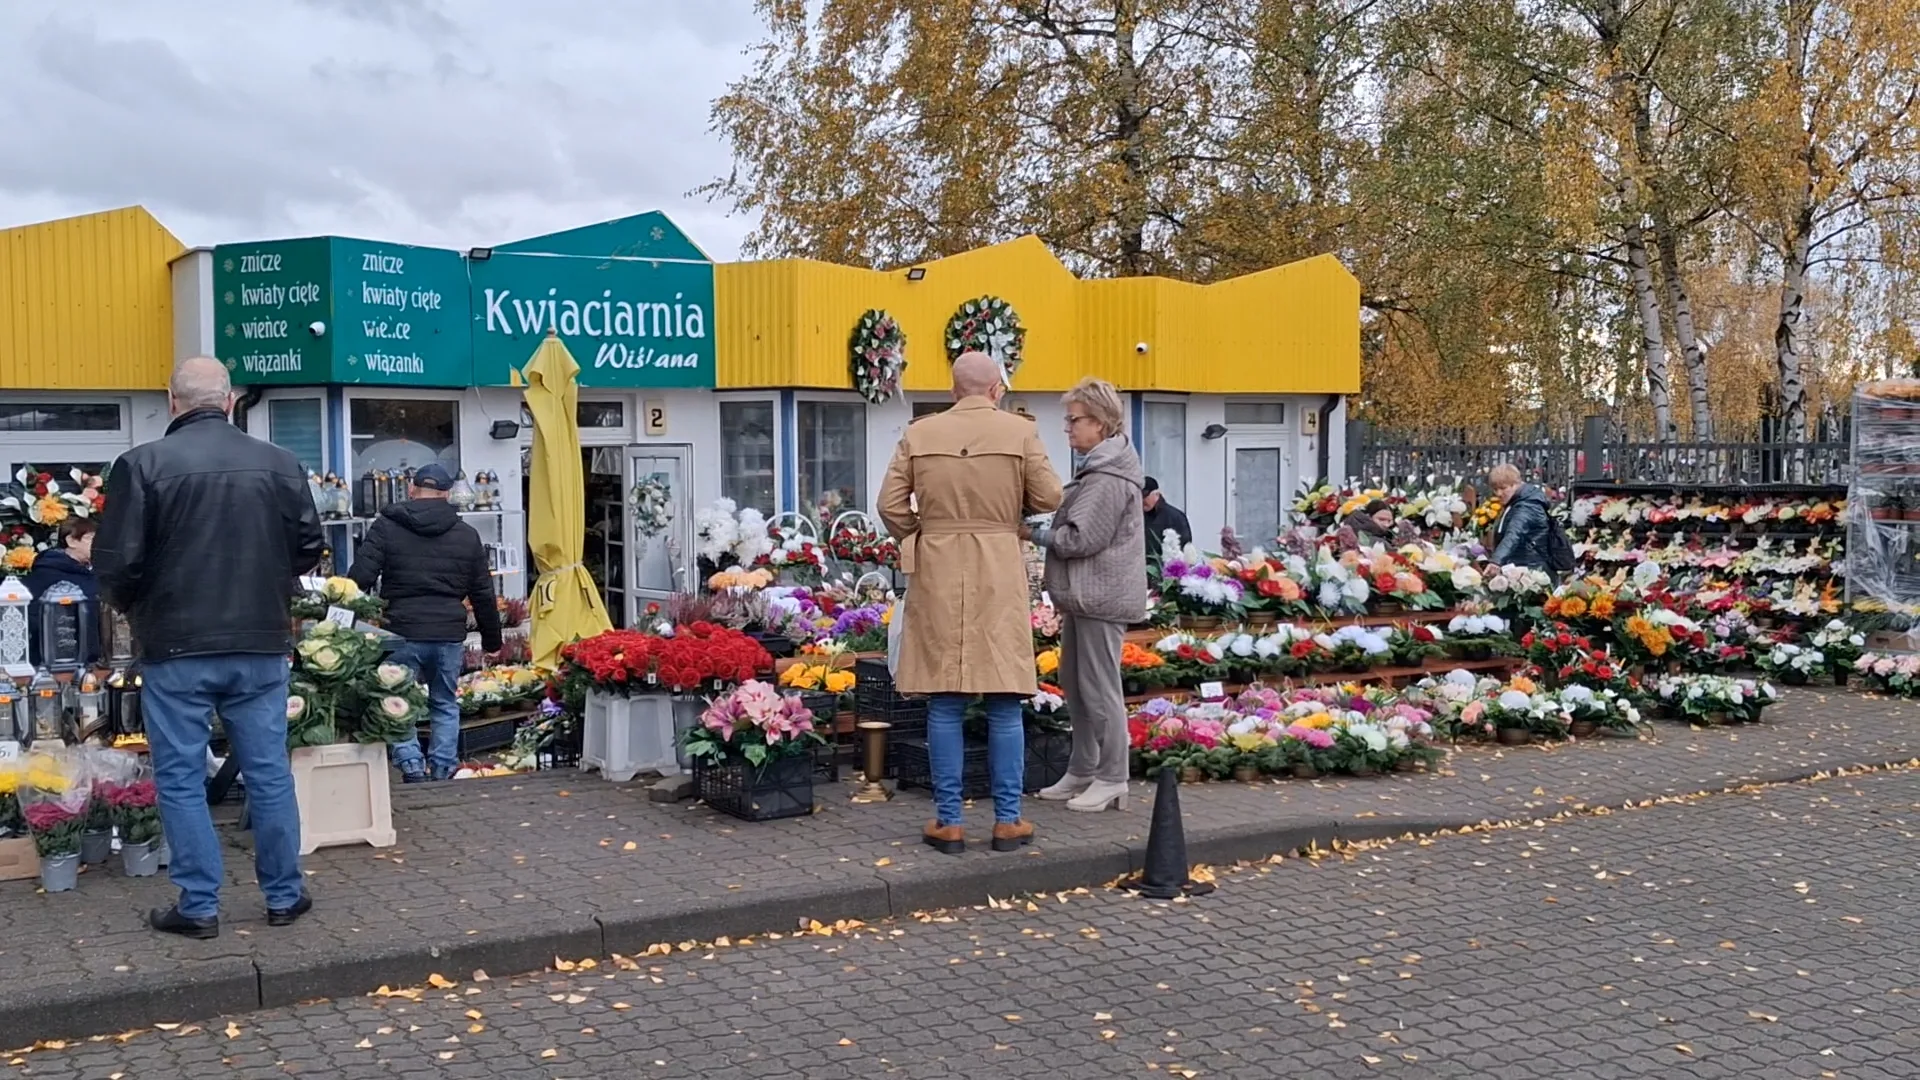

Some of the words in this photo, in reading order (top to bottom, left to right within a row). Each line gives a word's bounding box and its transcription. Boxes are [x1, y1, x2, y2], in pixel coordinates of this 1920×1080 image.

[241, 250, 282, 273] znicze
[362, 250, 404, 274] znicze
[241, 283, 285, 310] kwiaty
[289, 281, 320, 307] cięte
[362, 281, 408, 311] kwiaty
[411, 284, 441, 312] cięte
[484, 288, 705, 338] Kwiaciarnia
[242, 348, 301, 377] wiązanki
[364, 349, 424, 376] wiązanki
[651, 408, 663, 427] 2
